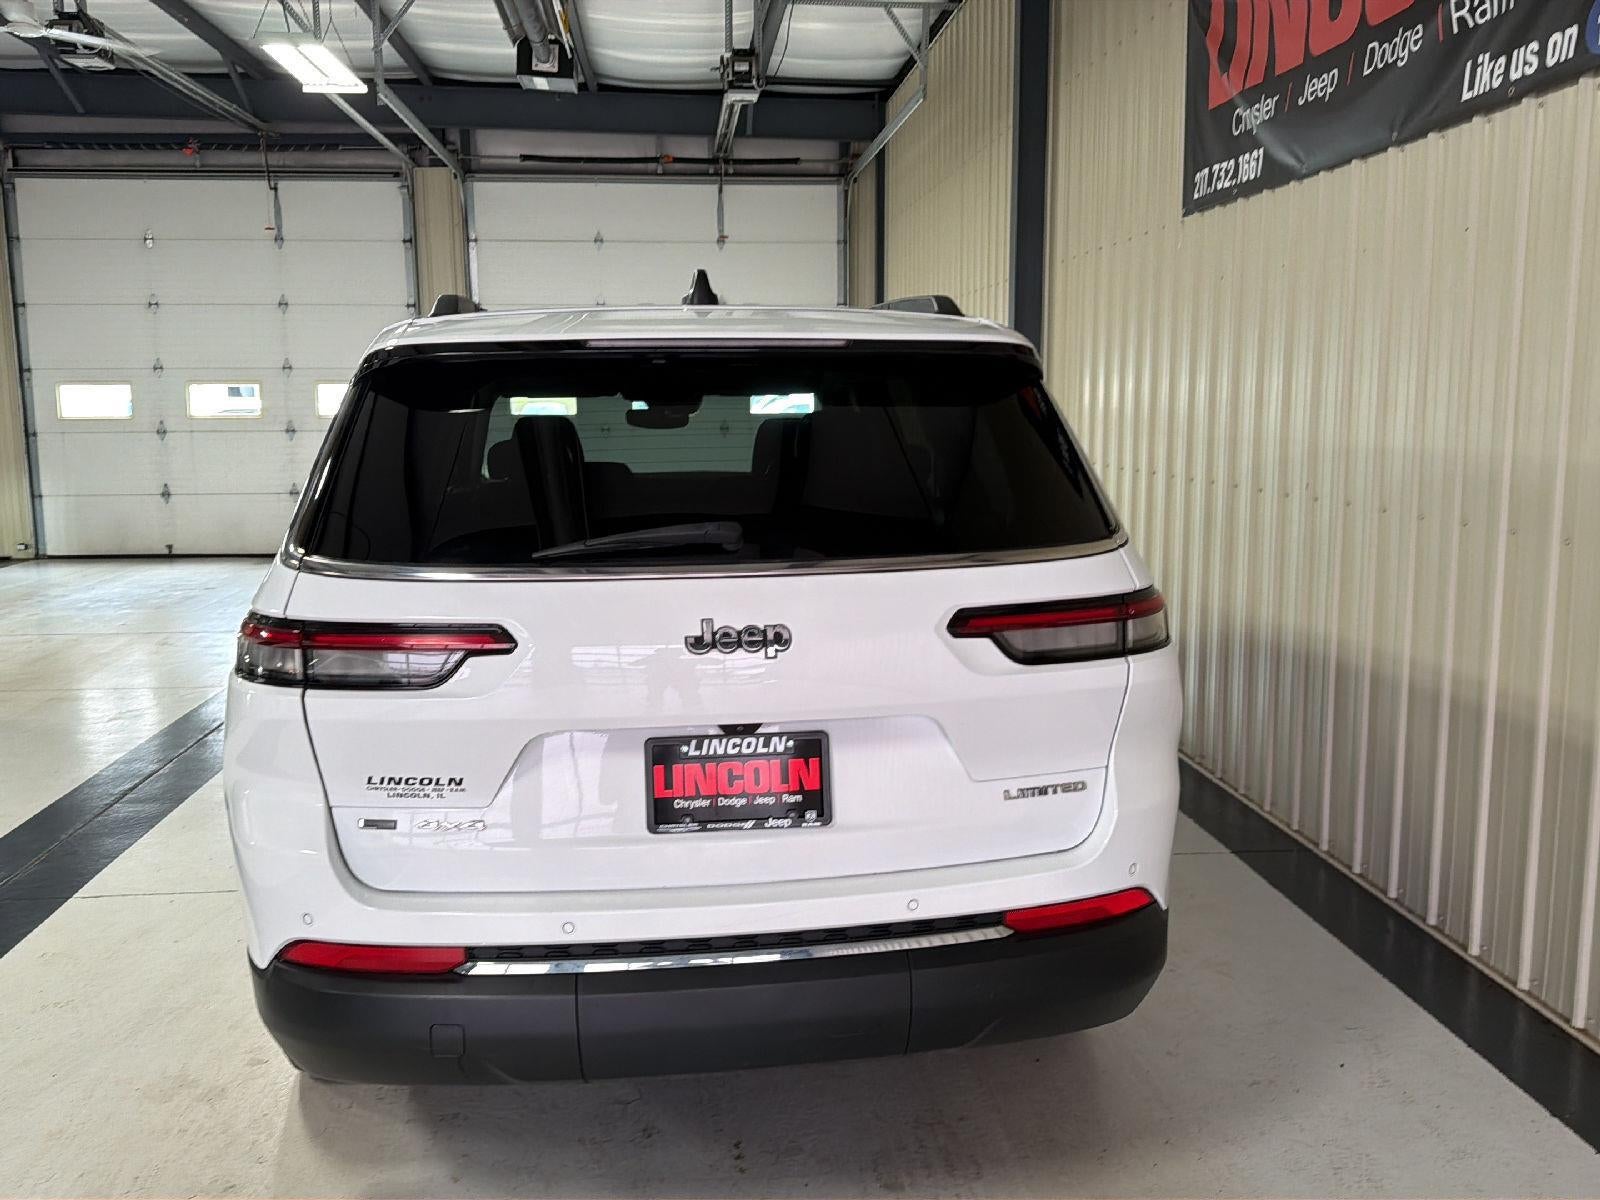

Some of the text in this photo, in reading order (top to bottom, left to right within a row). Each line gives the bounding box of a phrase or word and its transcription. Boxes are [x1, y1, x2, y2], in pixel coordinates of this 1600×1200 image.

[1298, 67, 1339, 106] Jeep
[1362, 24, 1424, 77] Dodge
[1461, 23, 1579, 102] Like us on
[684, 618, 793, 659] Jeep
[687, 736, 788, 756] LINCOLN
[366, 776, 464, 787] LINCOLN
[653, 757, 821, 799] LINCOLN
[673, 793, 803, 809] Chrysler Dodge Jeep Ram
[1003, 780, 1087, 801] LIMITED
[764, 817, 793, 829] Jeep
